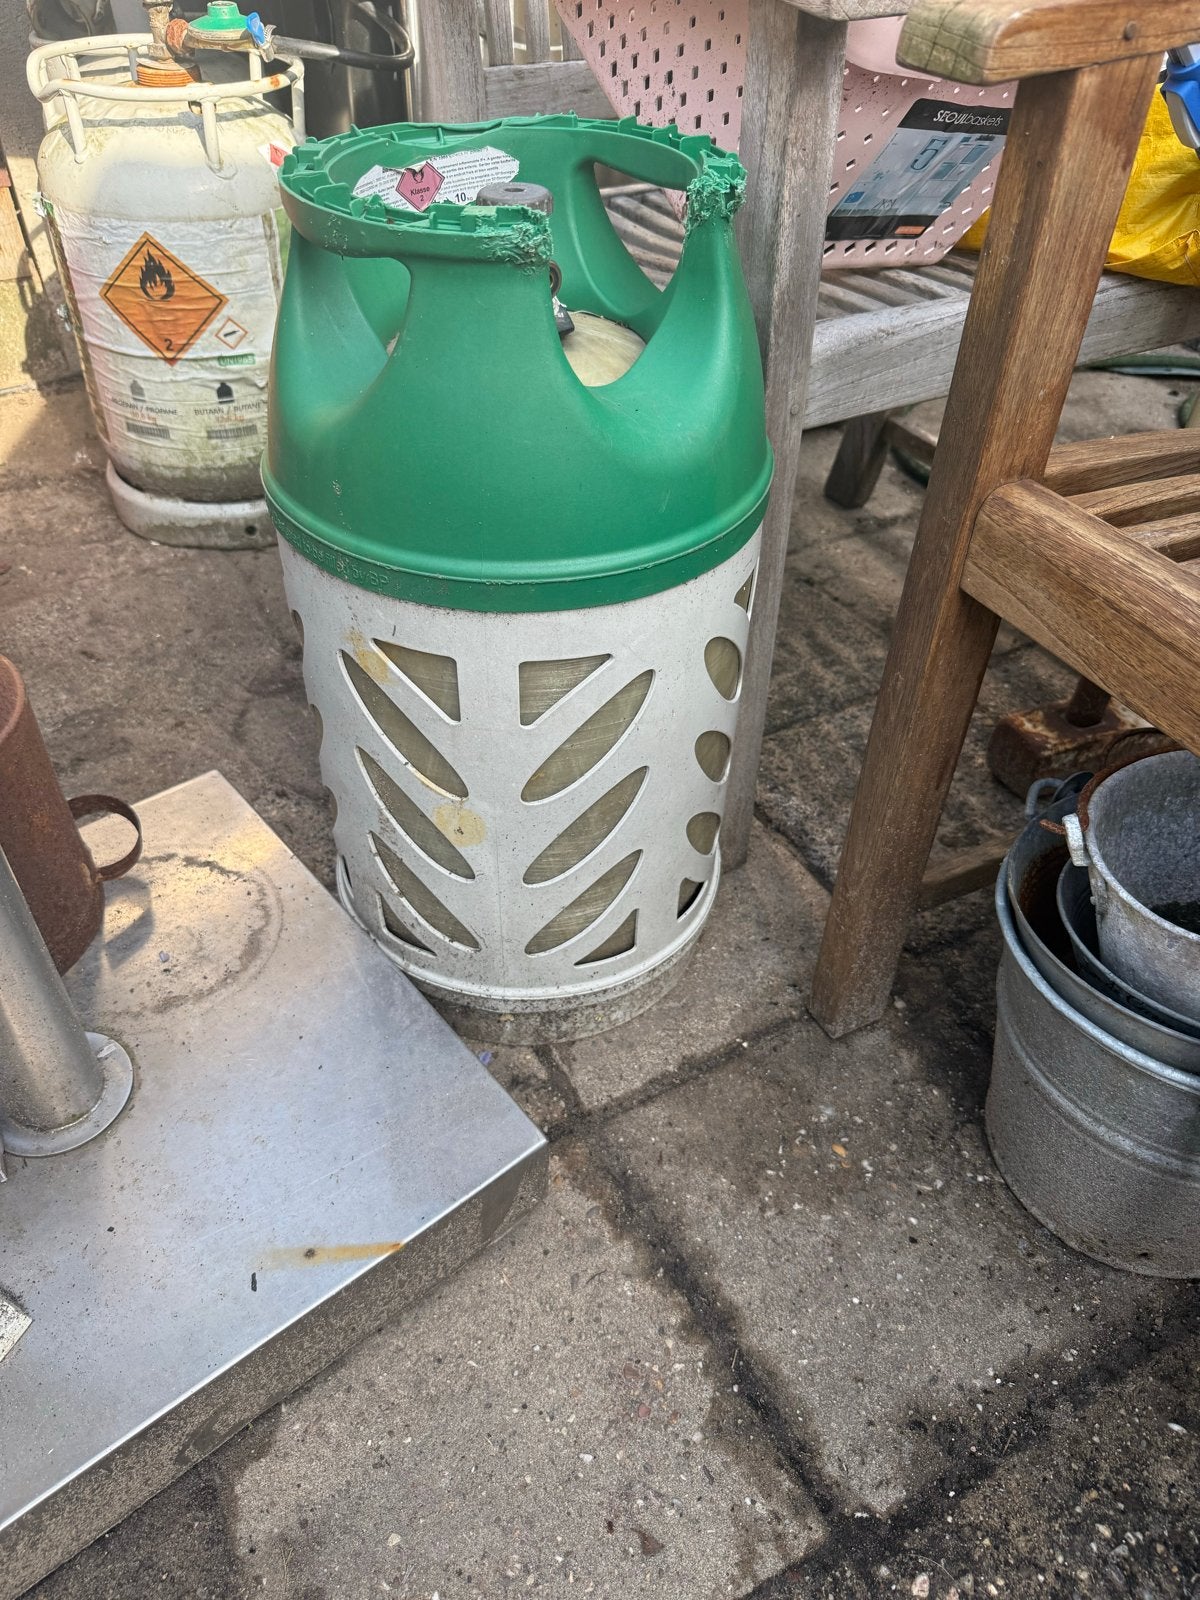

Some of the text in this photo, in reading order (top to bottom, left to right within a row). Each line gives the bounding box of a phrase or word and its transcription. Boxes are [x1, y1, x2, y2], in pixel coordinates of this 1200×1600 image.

[410, 186, 430, 196] Klasse
[455, 192, 467, 203] 10
[164, 338, 174, 351] 2
